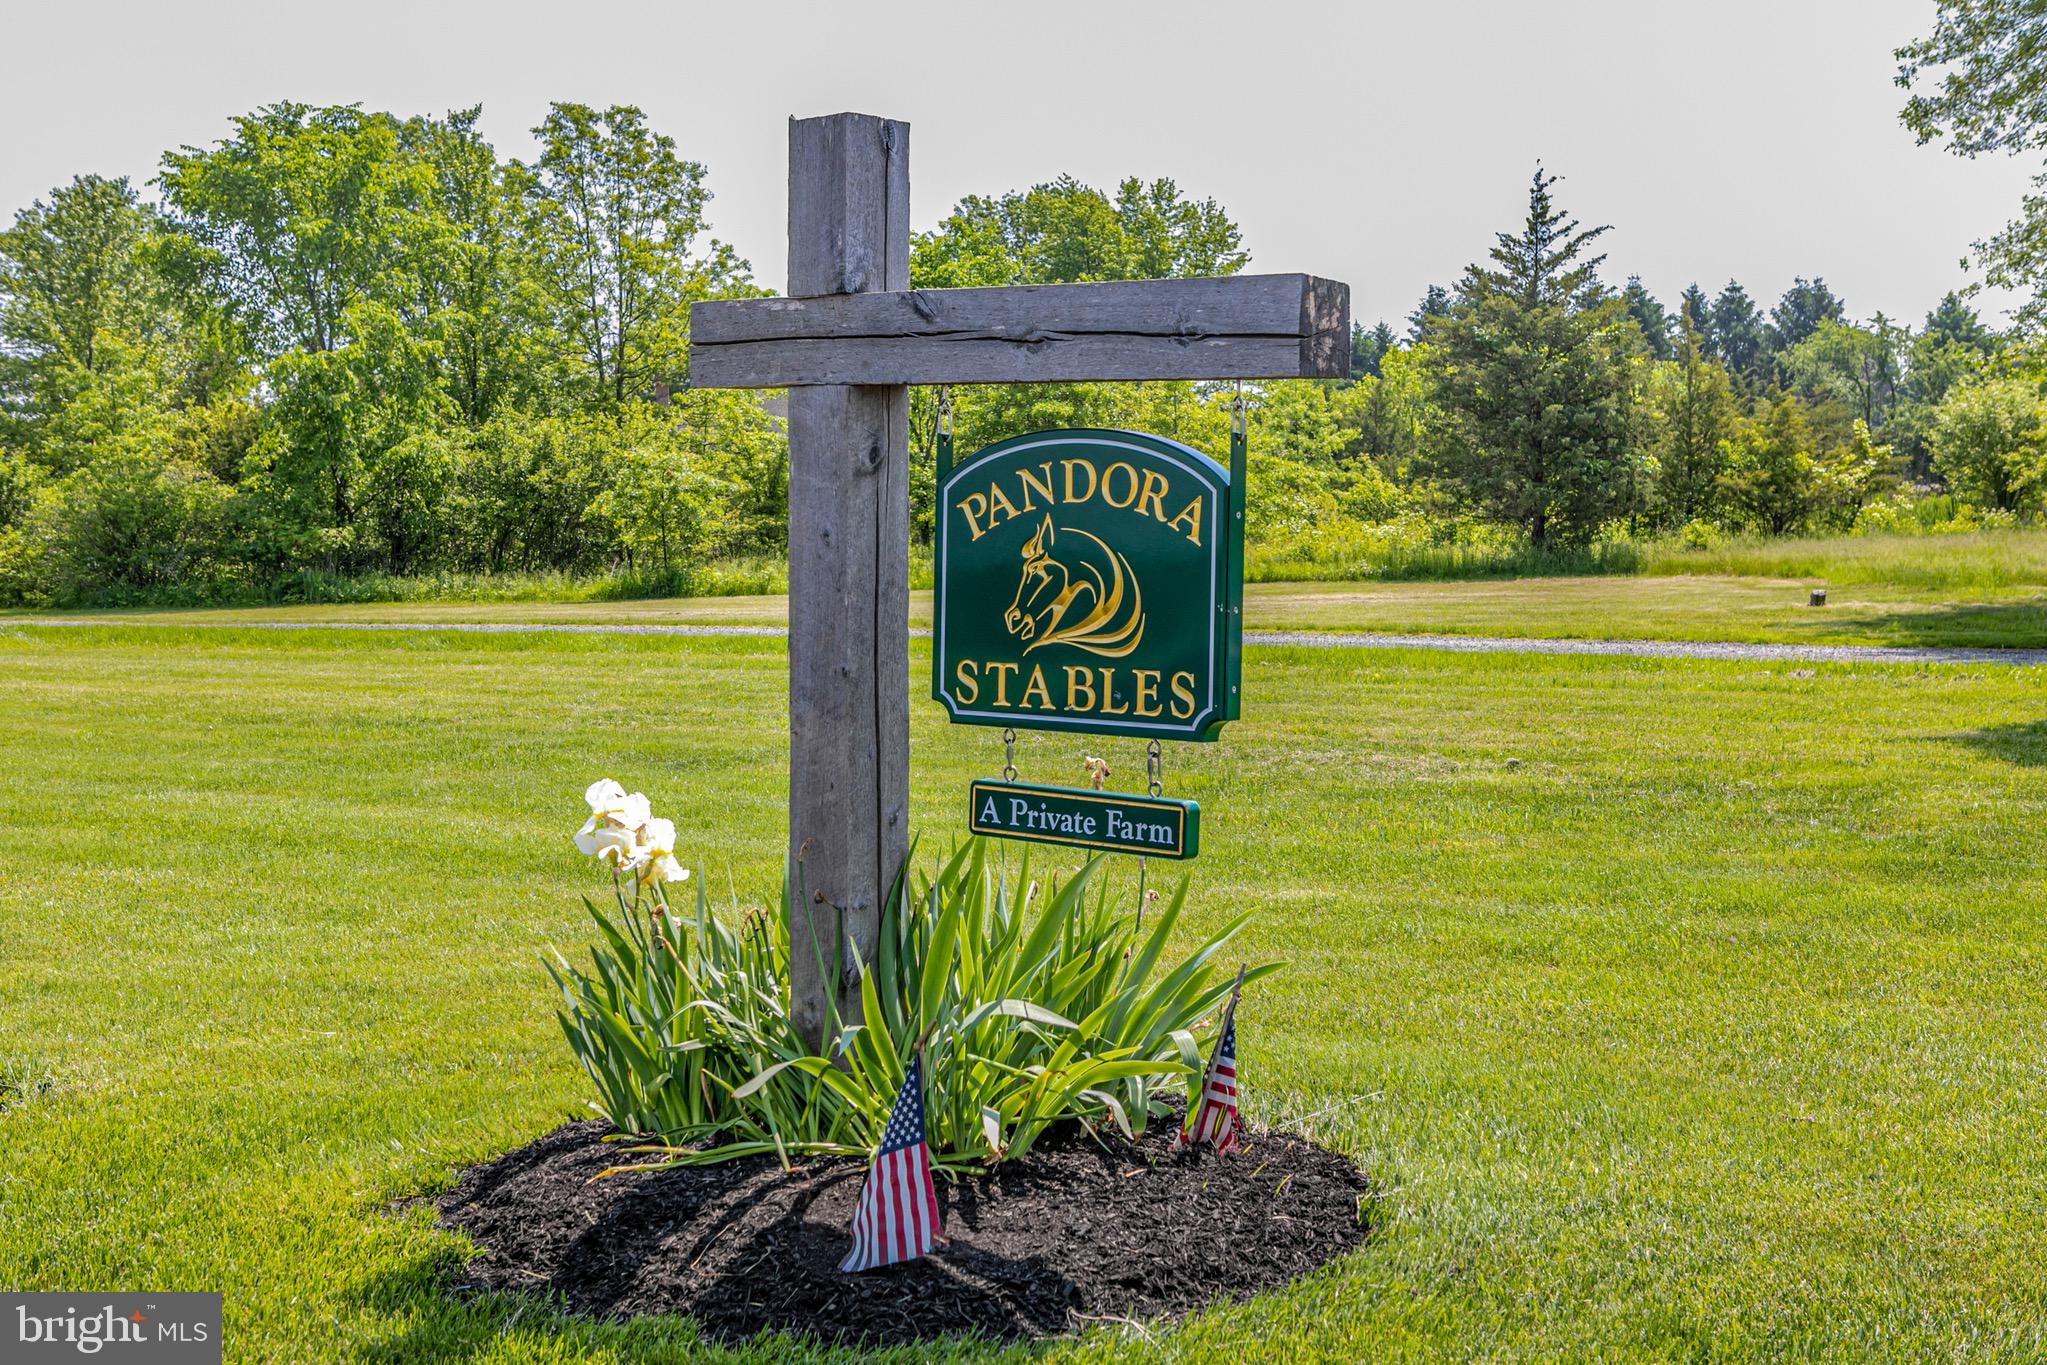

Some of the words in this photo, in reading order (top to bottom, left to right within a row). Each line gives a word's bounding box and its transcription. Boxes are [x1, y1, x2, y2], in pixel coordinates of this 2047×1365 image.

[956, 458, 1202, 547] PANDORA
[956, 659, 1196, 719] STABLES
[979, 795, 1001, 825] A
[1009, 798, 1096, 835] Private
[1105, 809, 1174, 845] Farm
